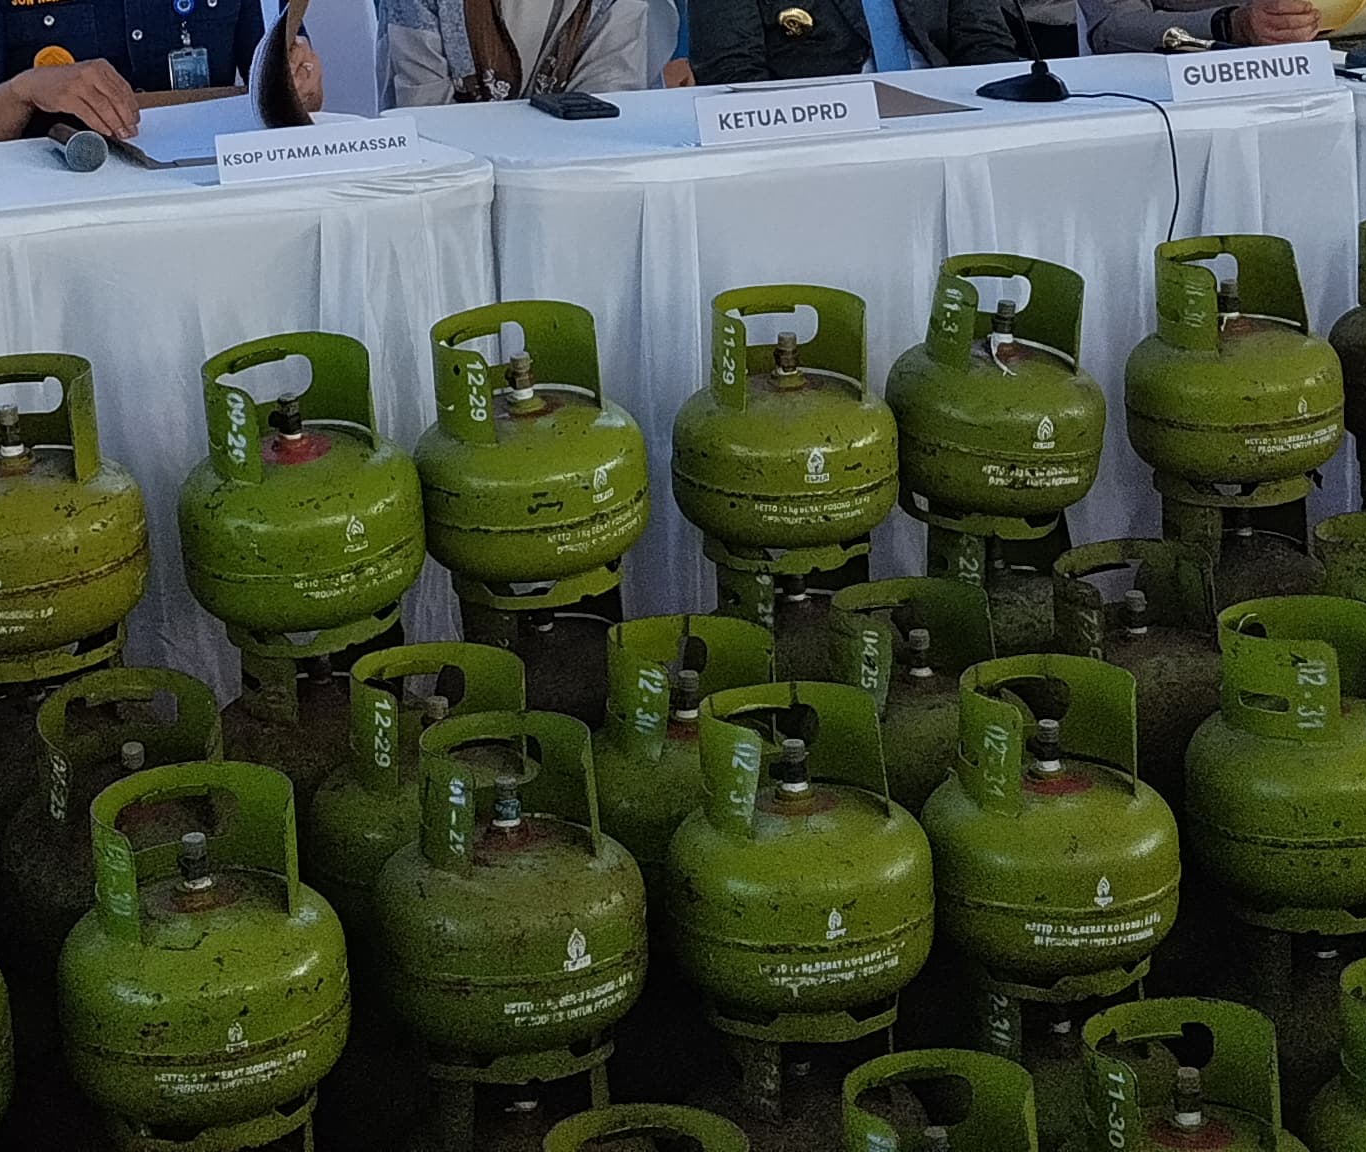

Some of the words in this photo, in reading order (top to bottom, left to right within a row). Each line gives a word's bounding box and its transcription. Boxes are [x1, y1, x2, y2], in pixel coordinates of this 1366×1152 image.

[1184, 56, 1311, 85] GUBERNUR
[718, 108, 787, 130] KETUA
[792, 102, 848, 123] DPRD
[223, 151, 263, 166] KSOP
[267, 145, 322, 162] UTAMA
[324, 136, 407, 156] MAKASSAR
[722, 323, 736, 385] 11-29
[466, 360, 486, 421] 12-29
[373, 699, 392, 768] 12-29
[1107, 1071, 1126, 1149] 11-30
